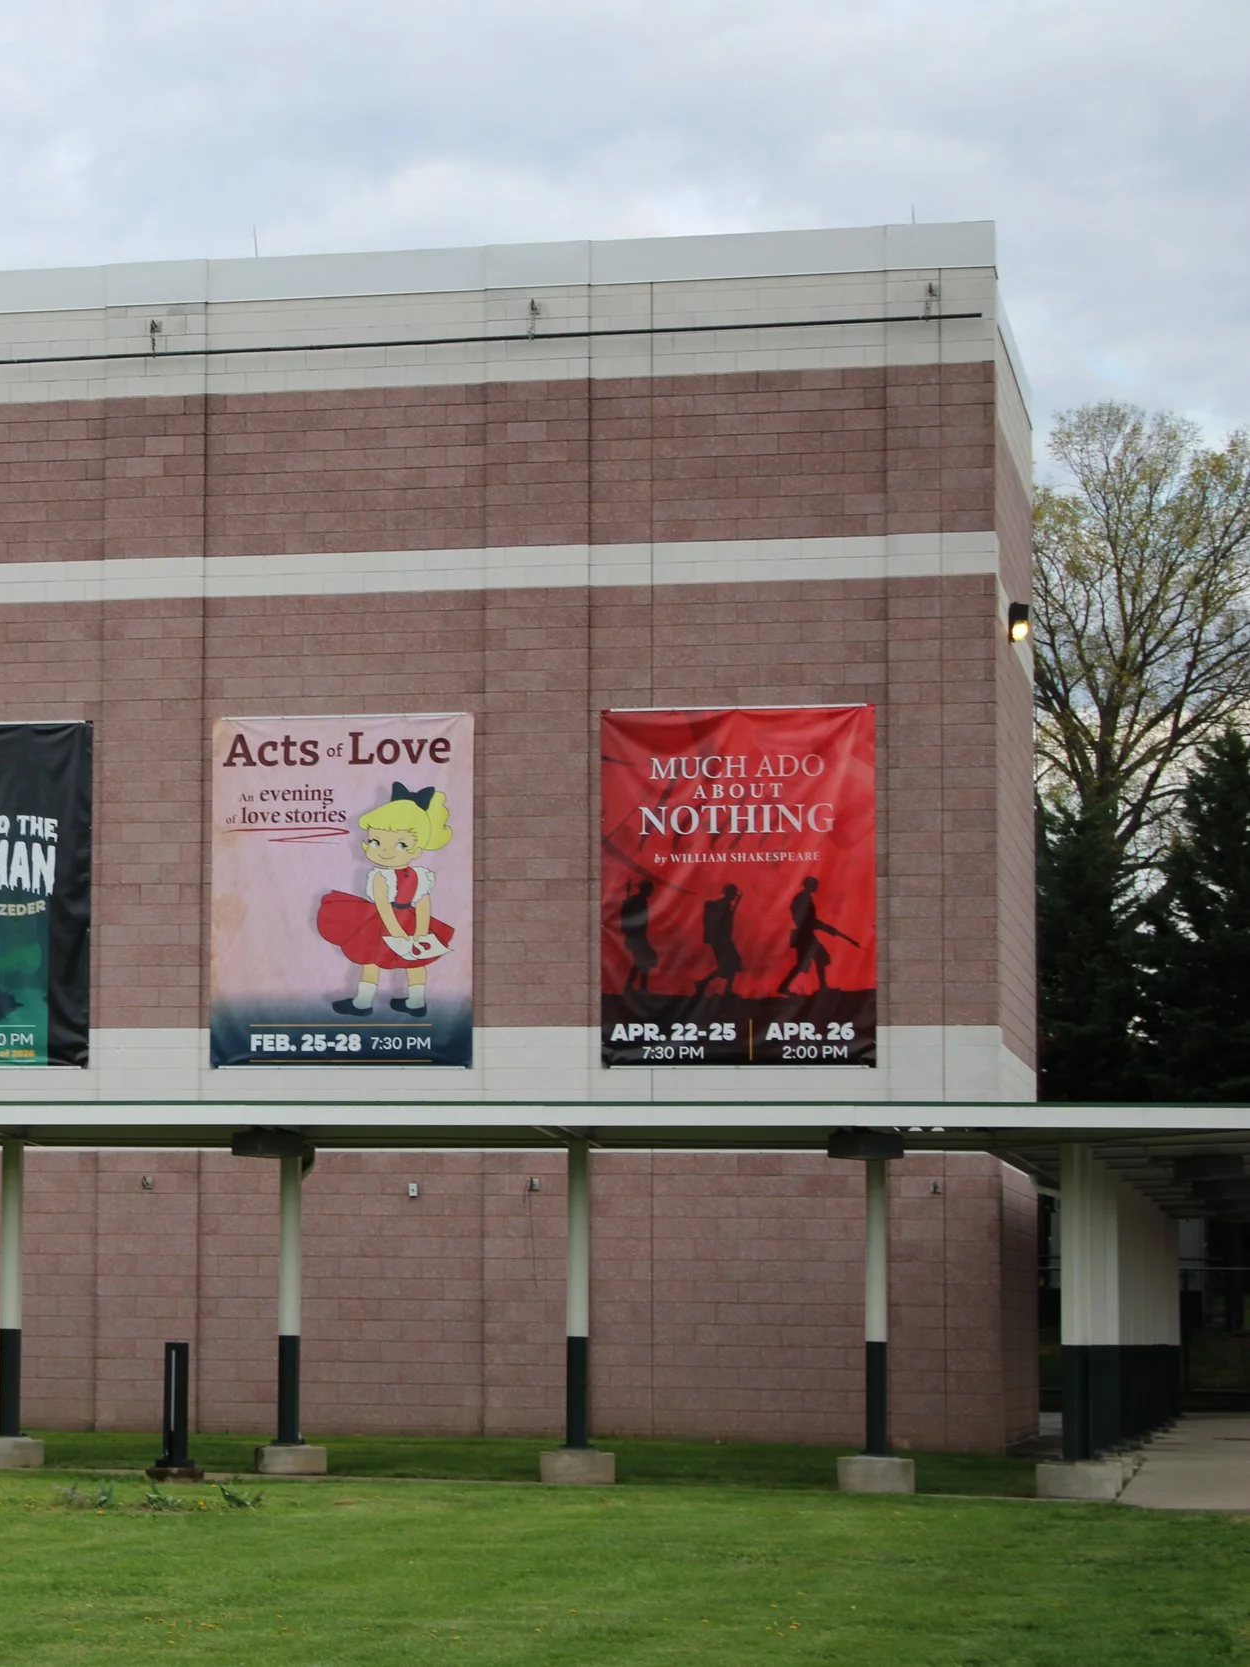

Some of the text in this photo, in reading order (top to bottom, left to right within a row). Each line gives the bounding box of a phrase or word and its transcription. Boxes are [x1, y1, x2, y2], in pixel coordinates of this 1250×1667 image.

[222, 731, 451, 767] Acts of Love
[649, 754, 825, 780] MUCH ADO
[238, 784, 334, 805] An evening
[693, 783, 783, 800] ABOUT
[225, 803, 347, 825] of love stories
[638, 803, 835, 836] NOTHING
[16, 815, 58, 842] THE
[653, 851, 821, 866] by WILLIAM SHAKESPEARE
[10, 1033, 34, 1046] PM
[610, 1023, 736, 1042] APR. 22-25
[765, 1022, 855, 1041] APR. 26
[250, 1033, 431, 1052] FEB. 25-28 7:30 PM
[0, 1049, 10, 1058] of
[642, 1047, 704, 1060] 7:30 PM
[781, 1046, 848, 1060] 2:00 PM
